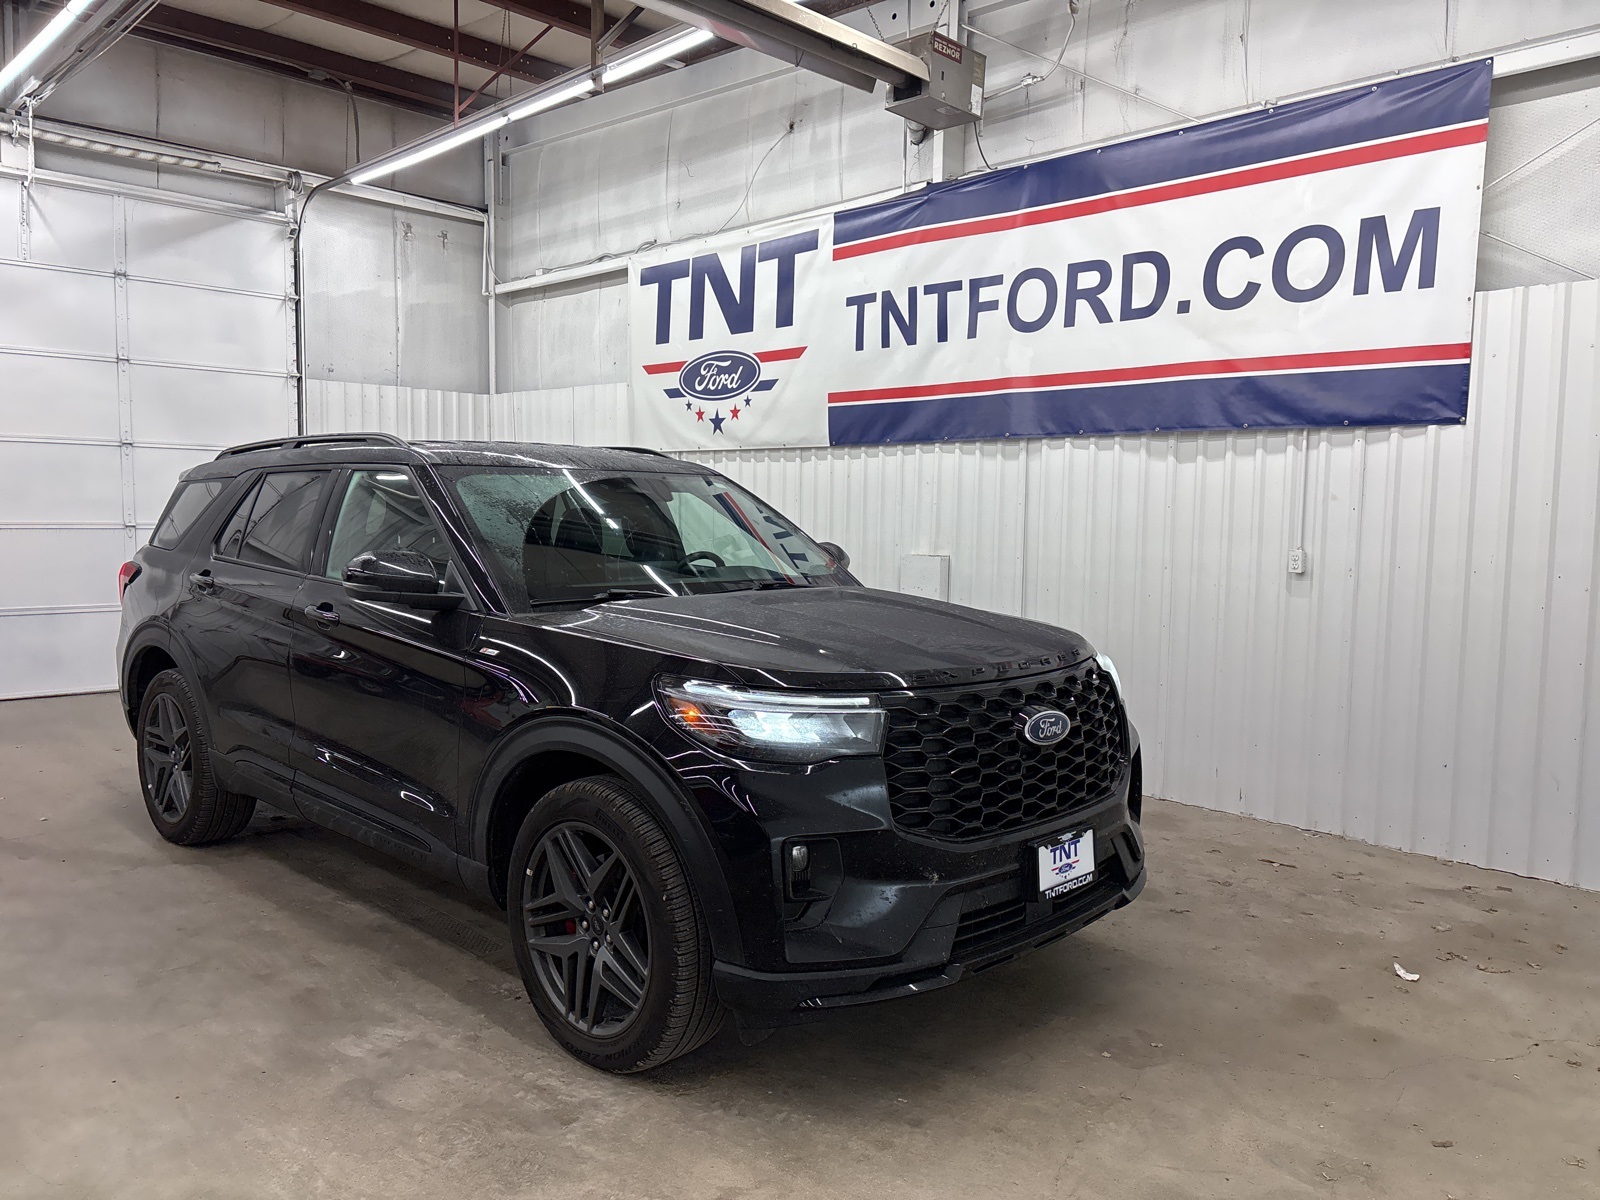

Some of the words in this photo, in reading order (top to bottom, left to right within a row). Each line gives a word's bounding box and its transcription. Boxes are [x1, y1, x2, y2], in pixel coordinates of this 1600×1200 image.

[934, 41, 960, 60] REZNOR
[640, 229, 819, 345] TNT
[846, 207, 1441, 351] TNTFORD.COM
[695, 360, 744, 391] Ford
[912, 648, 1081, 683] EXPLORER
[1038, 717, 1063, 738] Ford
[1050, 838, 1080, 865] TNT
[1045, 873, 1093, 899] TNTFORD.COM
